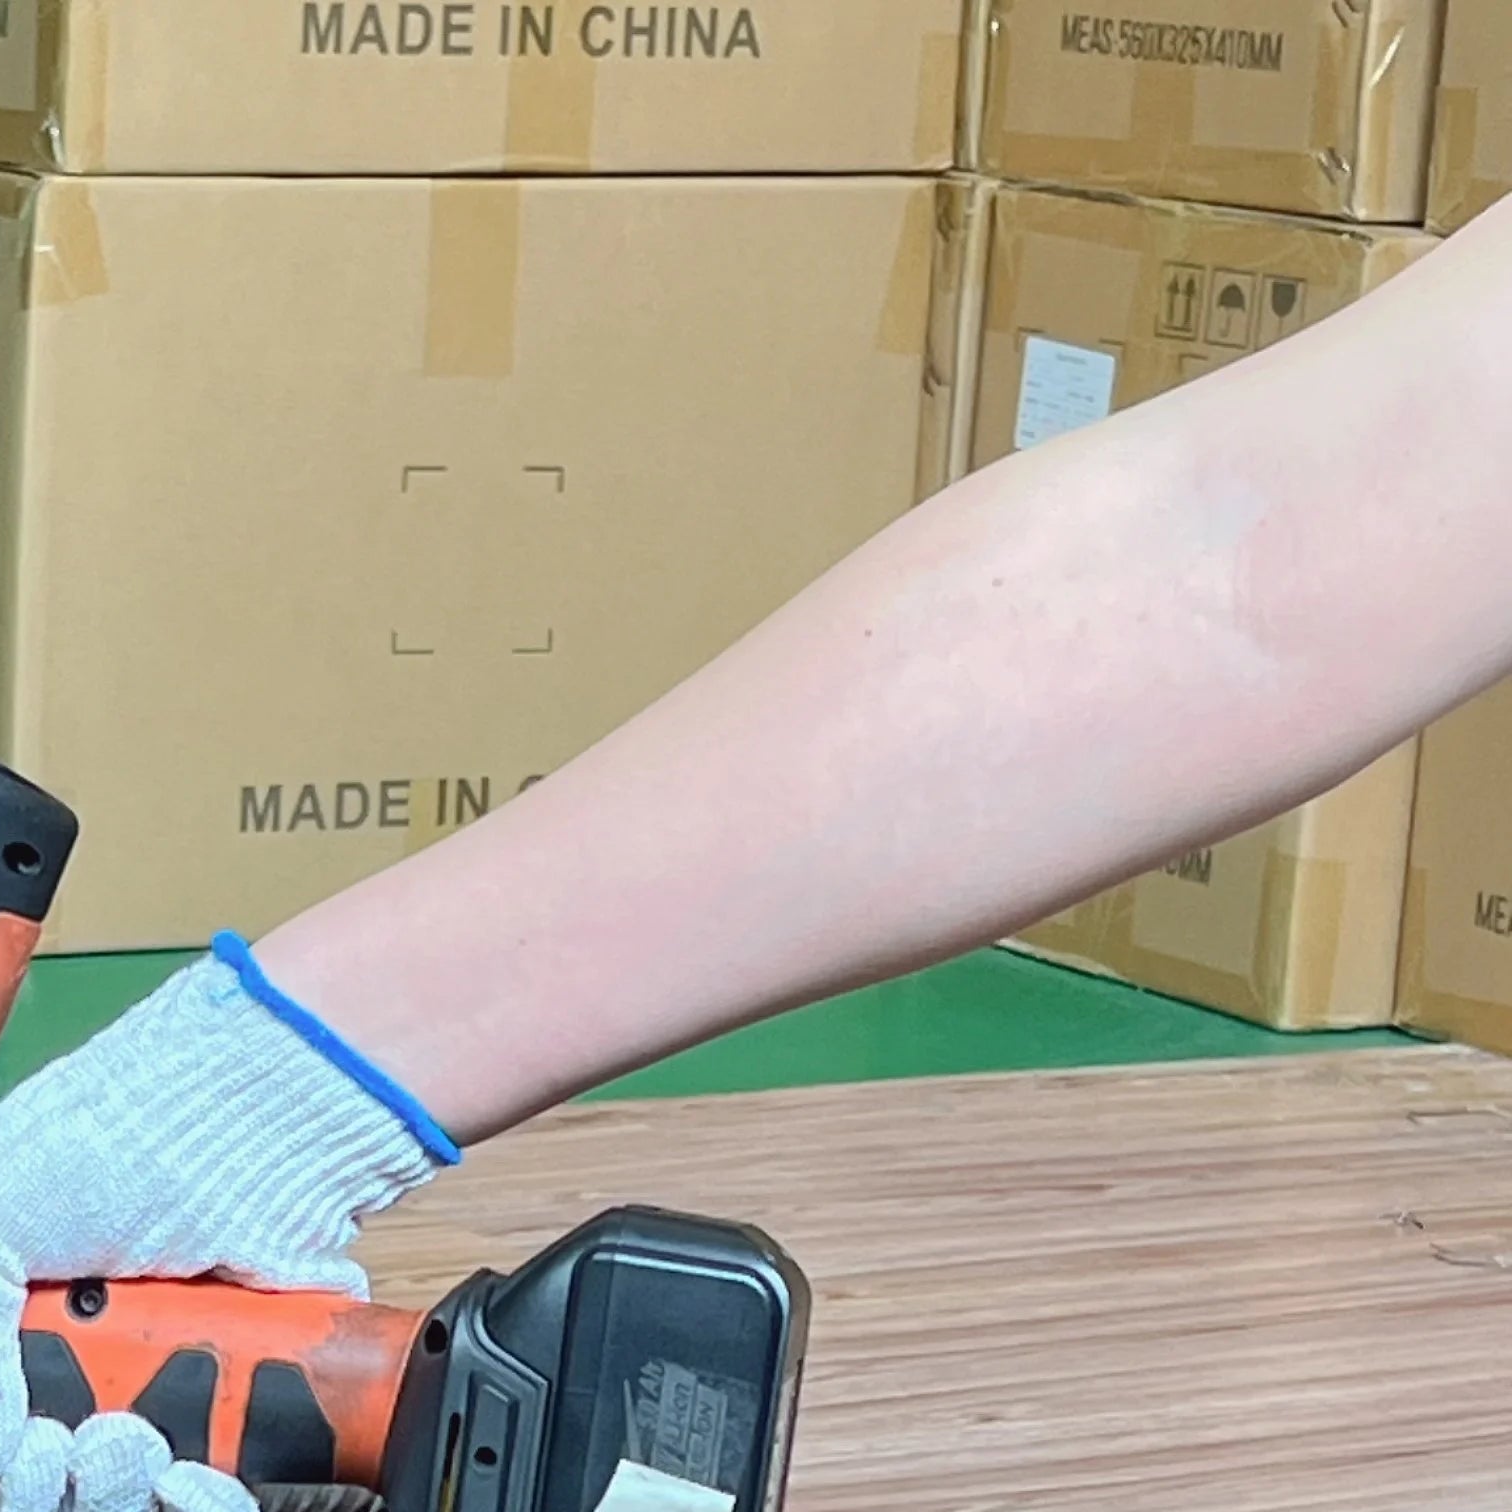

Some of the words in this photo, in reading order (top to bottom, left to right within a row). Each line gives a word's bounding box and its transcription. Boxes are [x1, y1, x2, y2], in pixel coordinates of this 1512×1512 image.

[300, 2, 474, 56] MADE
[498, 4, 553, 57] IN
[580, 6, 761, 59] CHINA
[239, 779, 412, 833] MADE
[436, 776, 490, 827] IN
